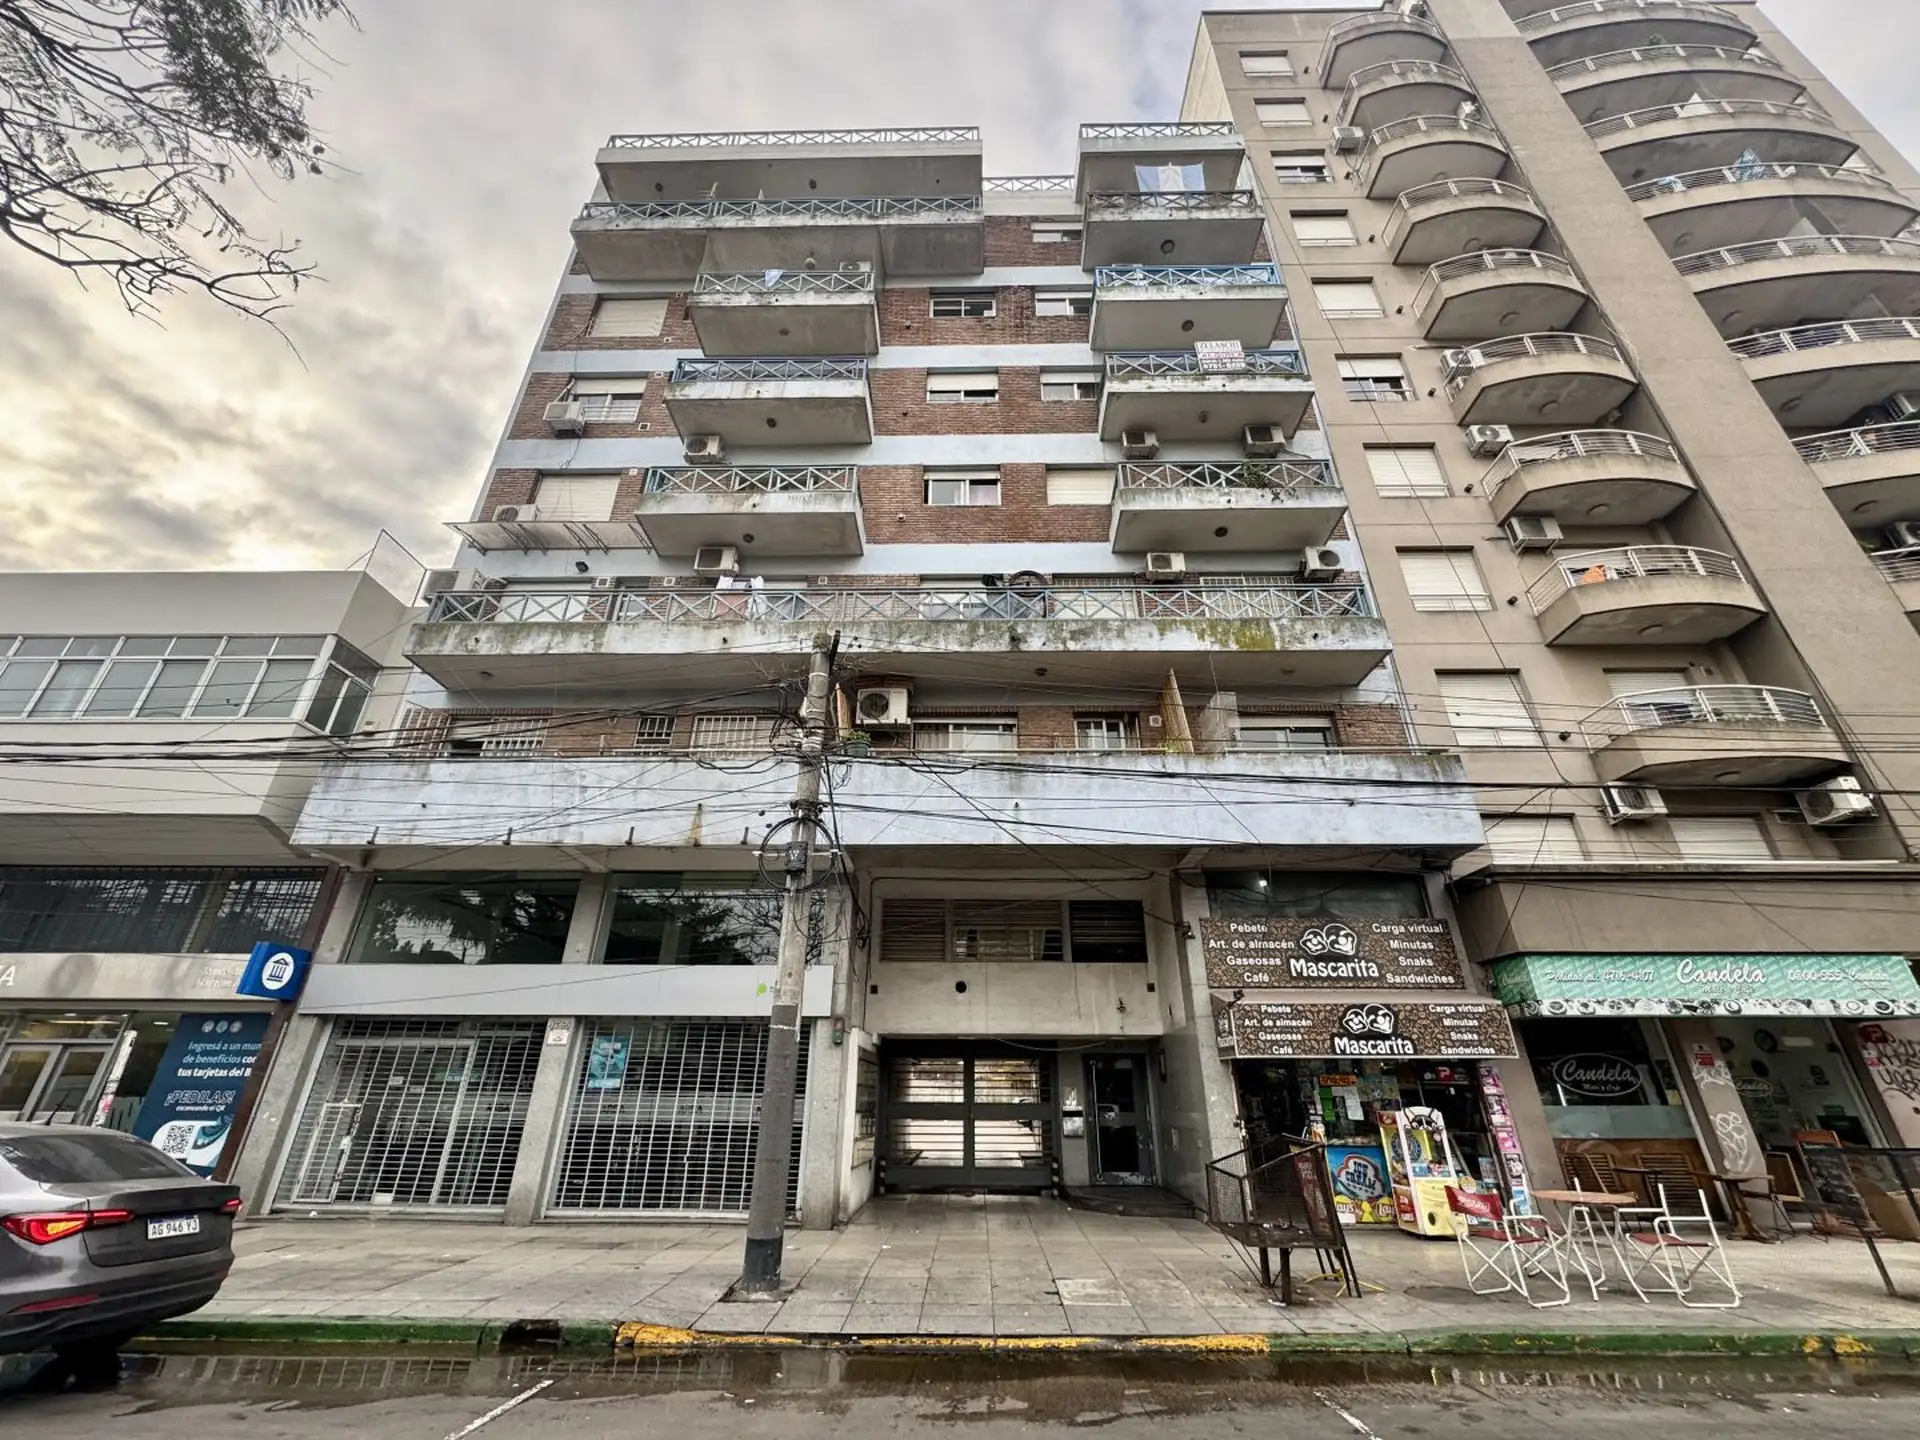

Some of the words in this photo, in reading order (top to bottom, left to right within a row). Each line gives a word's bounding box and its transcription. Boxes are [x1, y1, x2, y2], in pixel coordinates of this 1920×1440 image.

[1372, 923, 1405, 935] Carga
[1408, 923, 1444, 933] virtual
[1208, 939, 1229, 949] Art.
[1231, 939, 1246, 949] de
[1248, 939, 1295, 949] almacén
[1389, 940, 1434, 950] Minutas
[1226, 955, 1282, 966] Gaseosas
[1399, 956, 1434, 967] Snaks
[1289, 958, 1380, 978] Mascarita
[1676, 958, 1768, 984] Candela
[1243, 972, 1270, 982] Café
[1386, 973, 1455, 984] Sandwiches
[1260, 1004, 1292, 1013] Pebete
[1429, 1004, 1456, 1014] Carga
[1459, 1004, 1487, 1013] virtual
[1244, 1018, 1261, 1027] Art.
[1262, 1018, 1273, 1027] de
[1275, 1018, 1313, 1027] almacén
[1442, 1018, 1479, 1027] Minutas
[1258, 1032, 1302, 1041] Gaseosas
[1450, 1032, 1479, 1041] Snaks
[188, 1041, 221, 1052] Ingresá
[1272, 1045, 1293, 1055] Café
[1333, 1036, 1415, 1055] Mascarita
[1440, 1046, 1496, 1055] Sandwiches
[182, 1054, 195, 1064] de
[195, 1054, 241, 1064] beneficios
[177, 1067, 192, 1077] tus
[193, 1067, 227, 1079] tarjetas
[228, 1067, 243, 1077] del
[1562, 1059, 1638, 1082] Candela
[151, 1223, 163, 1237] AG
[166, 1221, 184, 1234] 946
